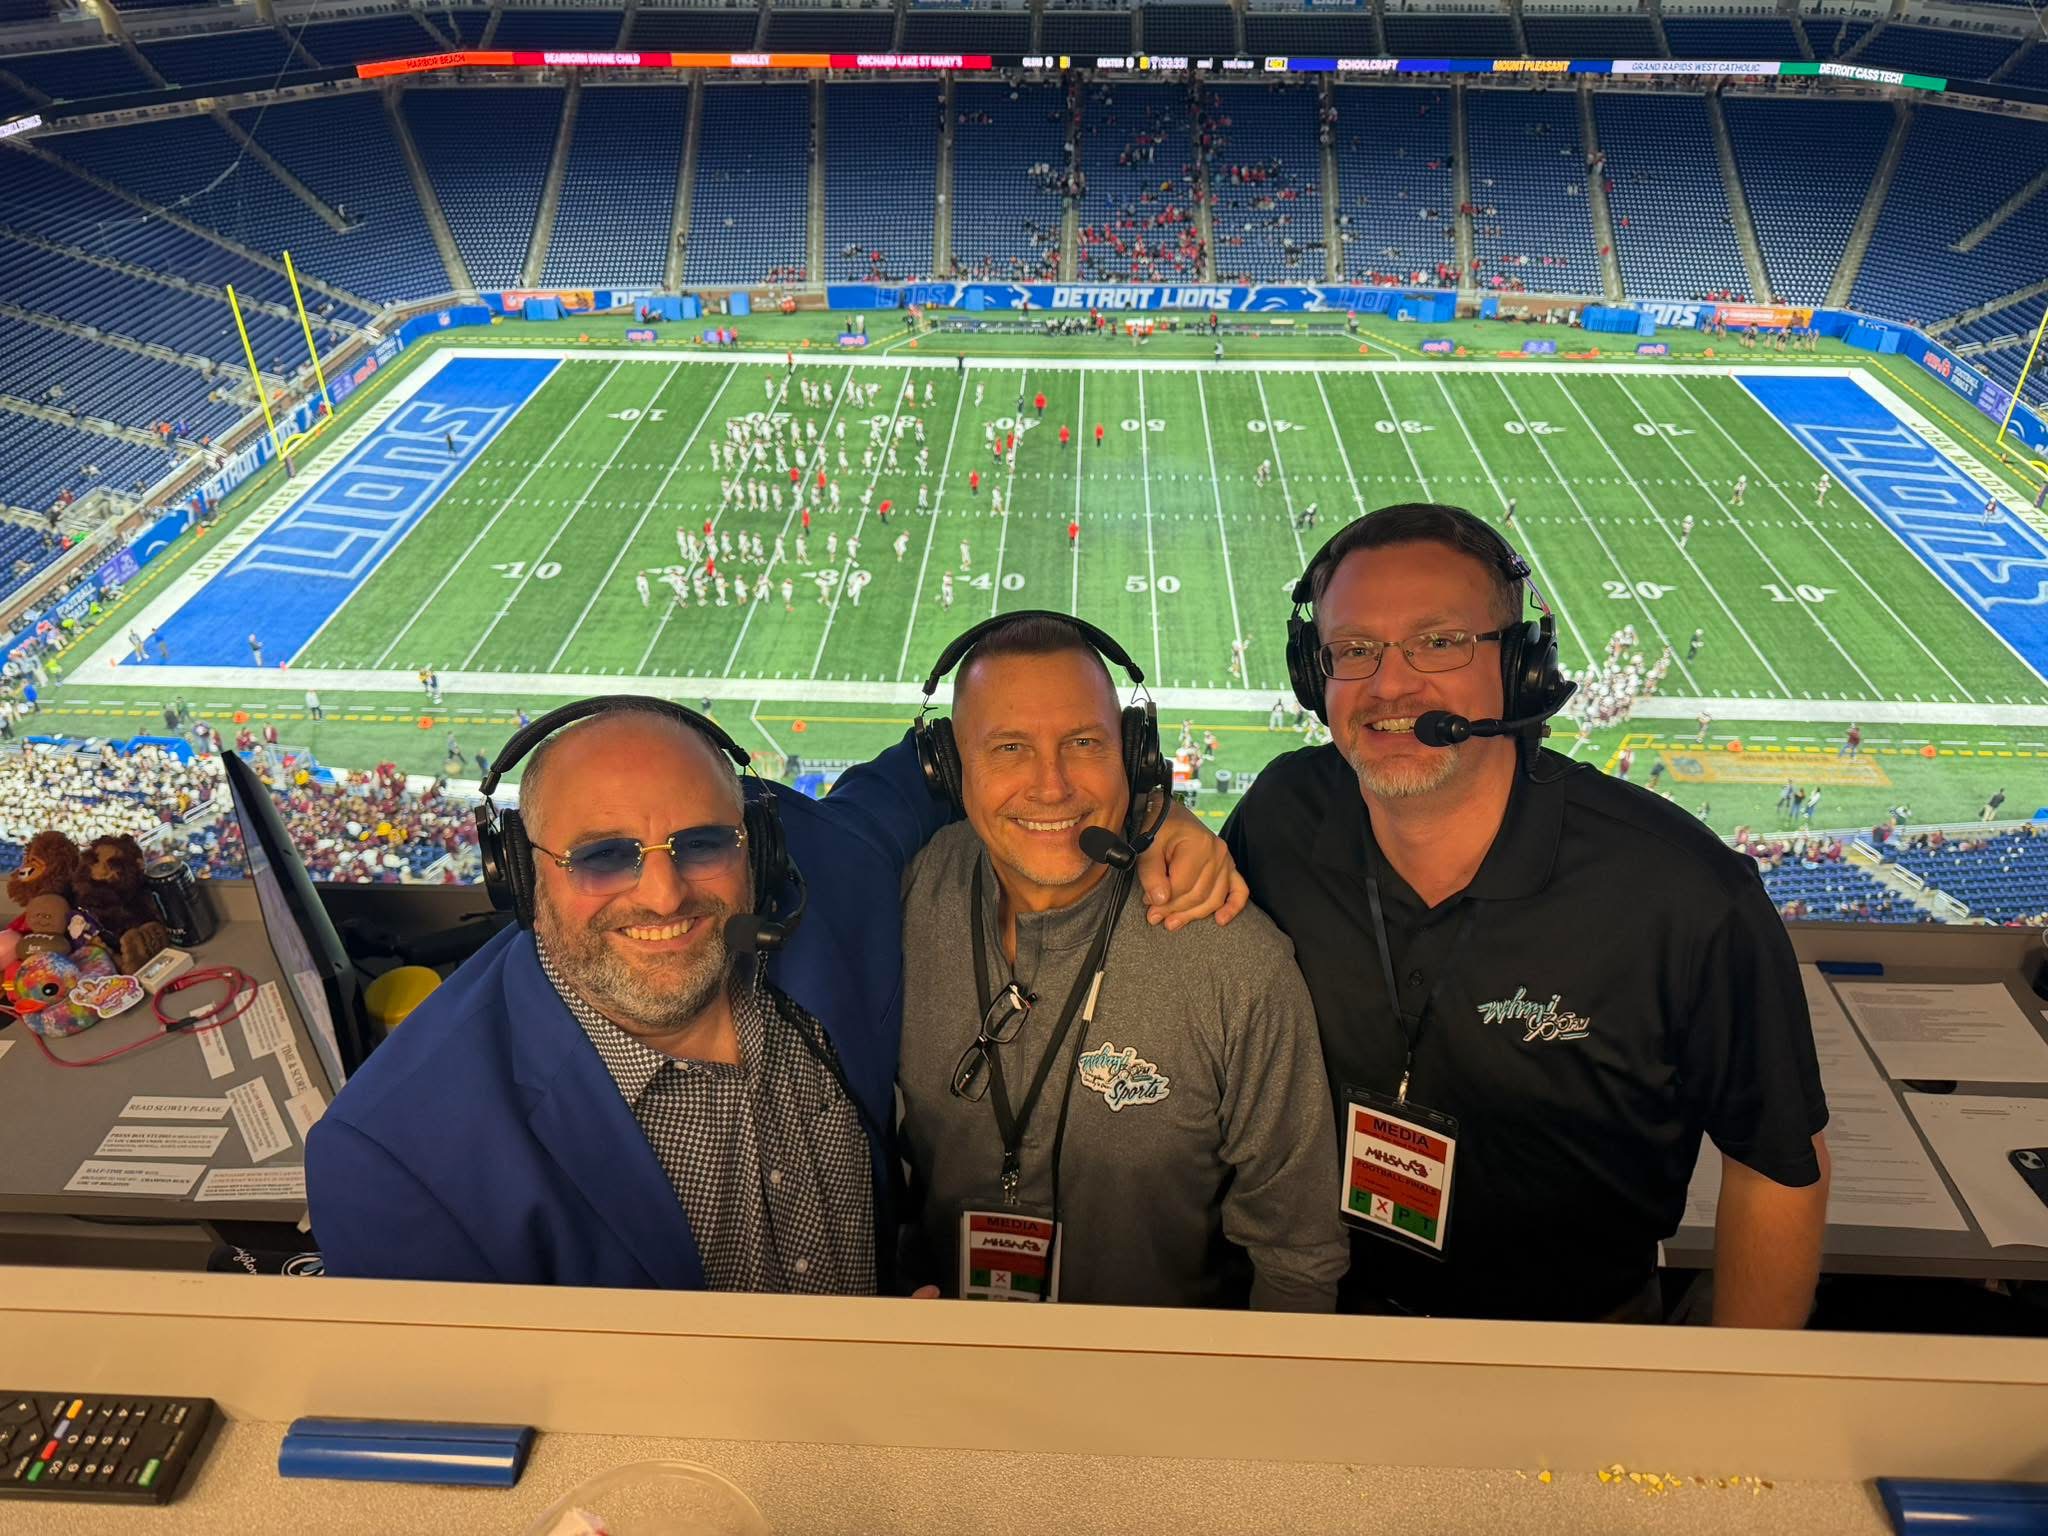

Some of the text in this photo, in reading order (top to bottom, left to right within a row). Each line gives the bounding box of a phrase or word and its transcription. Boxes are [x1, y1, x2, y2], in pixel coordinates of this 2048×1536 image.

[405, 55, 466, 69] HARBOR BEACH
[544, 53, 640, 65] DEARBORN DIVINE CHILD
[731, 54, 770, 66] KINGSLEY
[857, 55, 963, 67] ORCHARD LAKE ST MARY'S
[1336, 59, 1399, 72] SCHOOLCRAFT
[1493, 60, 1571, 73] MOUNT PLEASANT
[1631, 62, 1760, 73] GRAND RAPIDS WEST CATHOLIC
[1819, 62, 1904, 84] DETROIT CASS TECH
[1052, 286, 1232, 309] DETROIT LIONS
[1336, 289, 1394, 310] LION
[1911, 422, 2024, 504] JOHN MADDEN
[202, 450, 262, 502] DETROIT
[225, 399, 513, 579] LIONS
[1790, 422, 2048, 612] LIONS
[189, 540, 239, 582] JOHN
[240, 478, 303, 541] MADDEN
[502, 561, 564, 580] 10
[968, 572, 1026, 592] 40
[1125, 574, 1182, 594] 50
[1601, 580, 1666, 601] 20
[1760, 584, 1827, 604] 10
[281, 1043, 294, 1064] TIME
[291, 1068, 308, 1092] SCORE
[1109, 1078, 1164, 1106] Sports
[128, 1103, 153, 1112] READ
[154, 1103, 188, 1113] SLOWLY
[1372, 1118, 1430, 1150] MEDIA
[1355, 1190, 1367, 1204] F
[1375, 1197, 1389, 1215] X
[1397, 1208, 1411, 1222] P
[1421, 1216, 1434, 1231] T
[986, 1217, 1040, 1231] MEDIA
[101, 1408, 113, 1416] 7
[117, 1409, 128, 1417] 4
[135, 1409, 146, 1417] 1
[67, 1434, 79, 1444] 0
[84, 1434, 96, 1445] 8
[101, 1435, 114, 1445] 5
[118, 1436, 131, 1446] 2
[67, 1463, 80, 1473] 9
[85, 1463, 97, 1474] 6
[102, 1464, 114, 1474] 3
